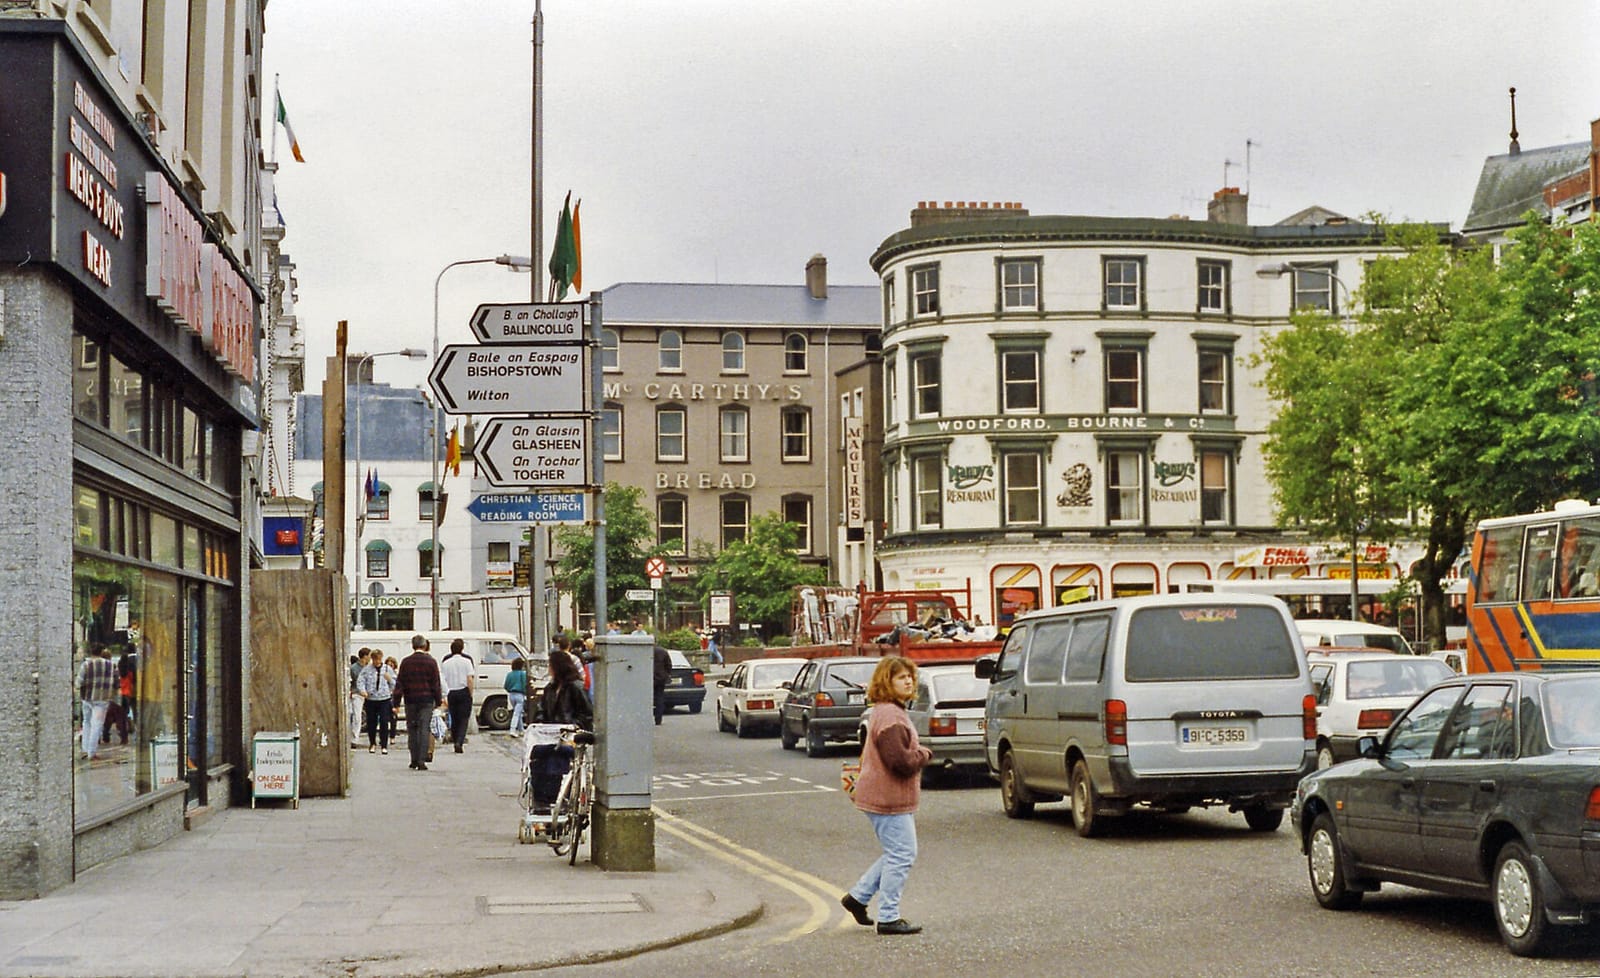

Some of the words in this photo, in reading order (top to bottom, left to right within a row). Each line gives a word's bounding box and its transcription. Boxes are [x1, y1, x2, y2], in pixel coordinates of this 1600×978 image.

[67, 152, 95, 212] MENS
[103, 188, 124, 241] BOYS
[83, 230, 112, 288] WEAR
[503, 310, 513, 320] B.
[517, 312, 529, 320] an
[503, 324, 574, 336] BALLINCOLLIG
[508, 354, 523, 363] an
[467, 366, 562, 377] BISHOPSTOWN
[1067, 417, 1148, 429] BOURNE
[1164, 417, 1175, 428] &
[512, 425, 529, 437] An
[512, 440, 581, 450] GLASHEEN
[513, 456, 530, 467] An
[537, 456, 581, 467] Tochar
[513, 469, 566, 480] TOGHER
[848, 427, 861, 521] MAGUIRES
[656, 472, 757, 490] BREAD
[480, 495, 532, 504] CHRISTIAN
[537, 494, 576, 503] SCIENCE
[946, 488, 996, 503] RESTAURANT
[1151, 488, 1198, 503] RESTAURANT
[542, 503, 581, 512] CHURCH
[480, 512, 523, 520] READING
[528, 511, 558, 520] ROOM
[1264, 547, 1307, 557] FREE
[1262, 556, 1310, 566] DRAW
[360, 597, 417, 607] OUDOORS
[257, 774, 269, 782] ON
[271, 774, 290, 782] SALE
[264, 782, 285, 790] HERE
